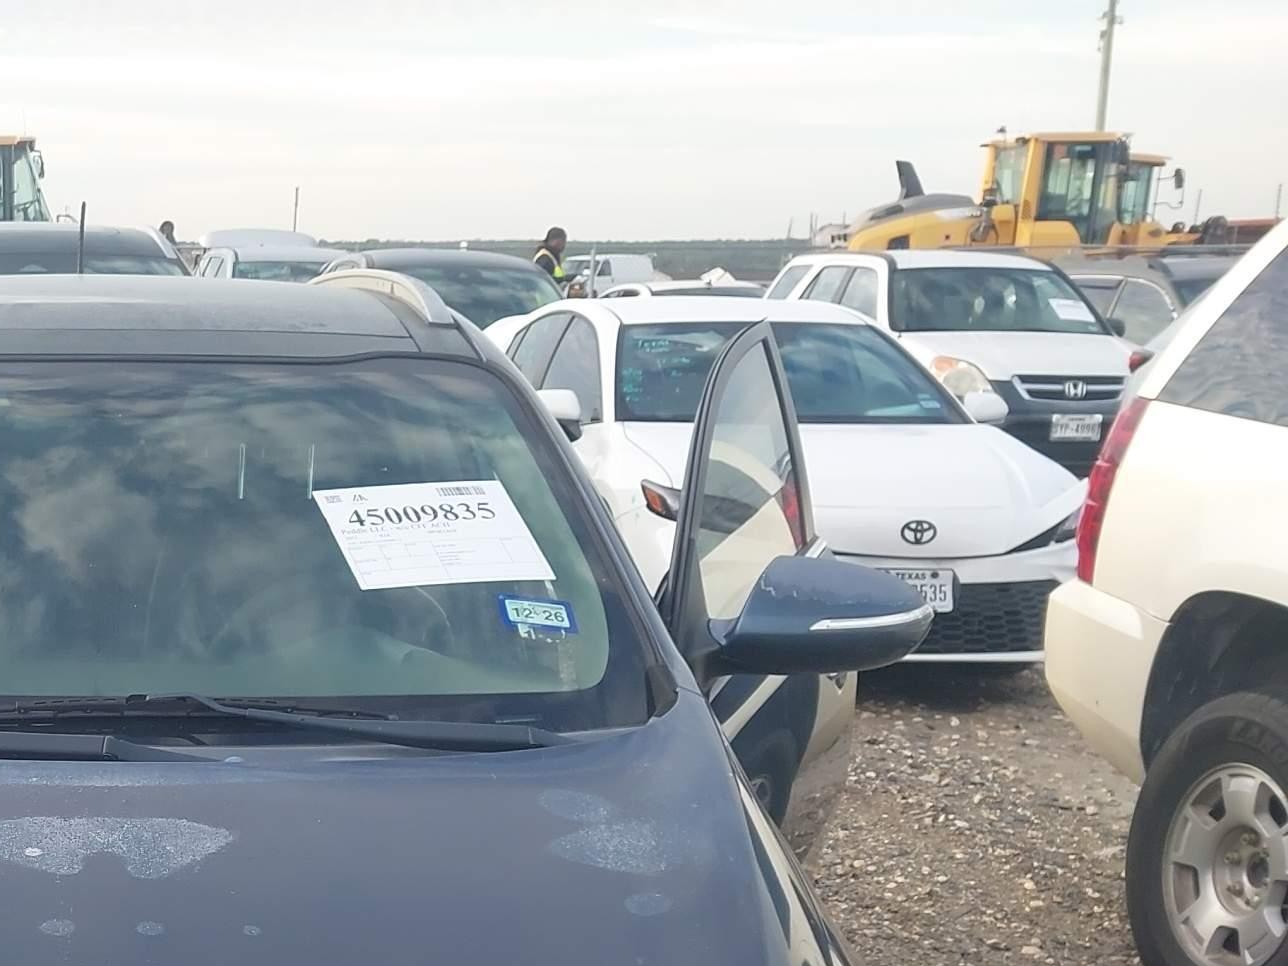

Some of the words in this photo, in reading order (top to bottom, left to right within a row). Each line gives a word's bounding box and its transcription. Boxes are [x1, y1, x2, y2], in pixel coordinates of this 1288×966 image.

[349, 502, 496, 526] 45009835
[913, 584, 947, 601] 535
[543, 610, 565, 622] 26
